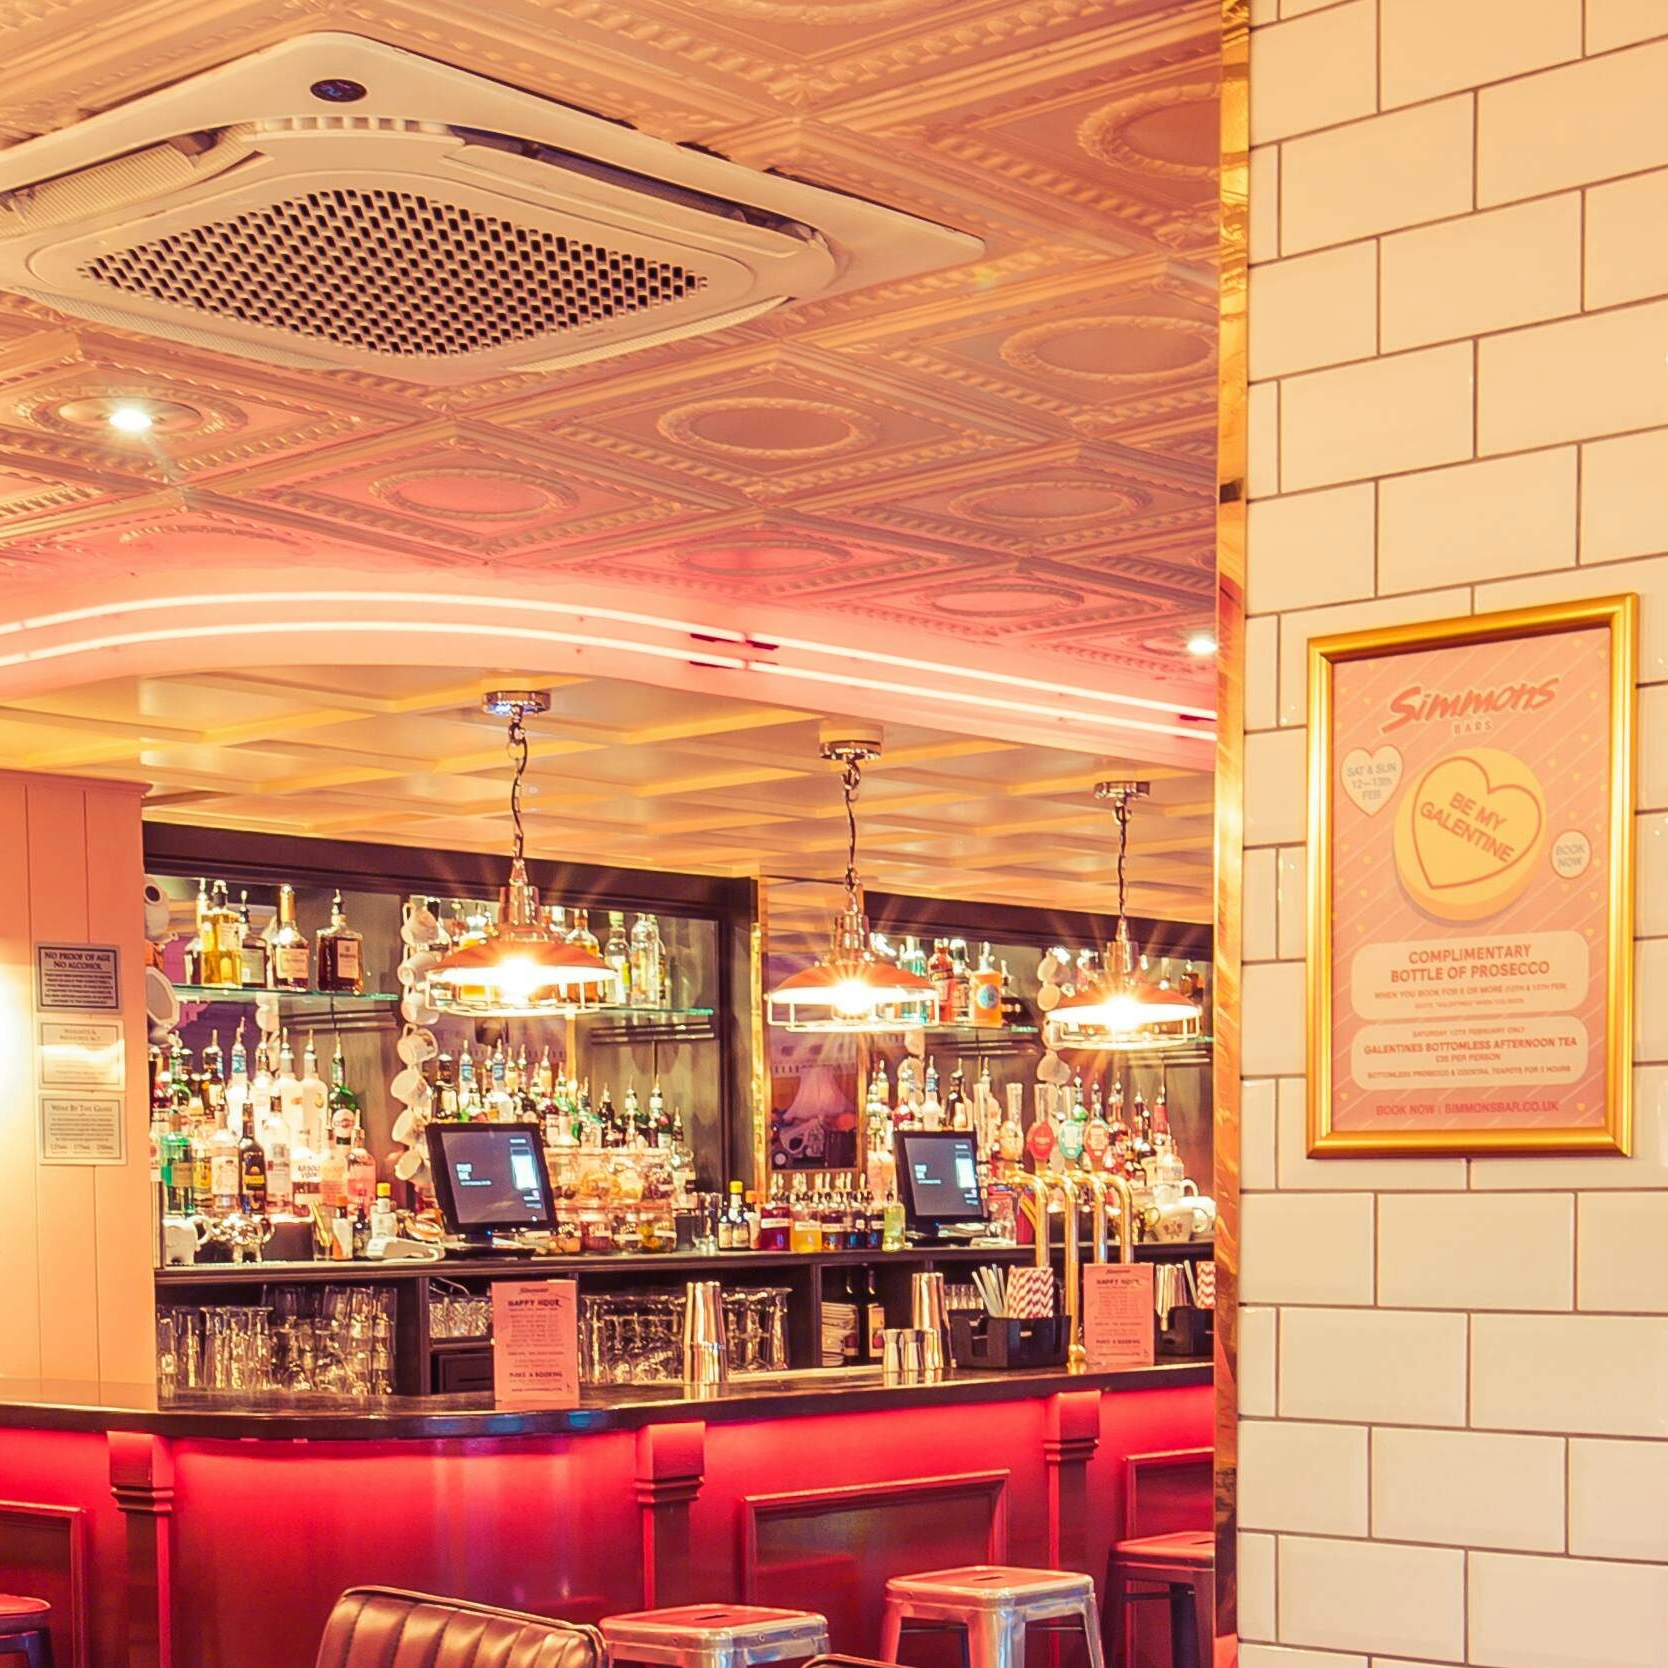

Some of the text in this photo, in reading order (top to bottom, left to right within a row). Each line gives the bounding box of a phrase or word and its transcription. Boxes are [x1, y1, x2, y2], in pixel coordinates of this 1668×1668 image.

[1381, 676, 1560, 734] Simmons
[1453, 721, 1493, 734] BARS
[1347, 766, 1366, 777] SAT
[1376, 763, 1397, 774] SUN
[1362, 790, 1382, 800] FEB
[1449, 791, 1507, 832] BE MY
[1420, 801, 1515, 863] GALENTINE
[1556, 843, 1585, 856] BOOK
[1558, 857, 1583, 869] NOW
[1408, 944, 1531, 965] COMPLIMENTARY
[1390, 961, 1550, 983] BOTTLE OF PROSECCO
[1364, 1036, 1577, 1055] GALENTINES BOTTOMLESS AFTERNOON TEA
[1376, 1100, 1559, 1117] BOOK NOW SIMMONSBAR.CO.UK
